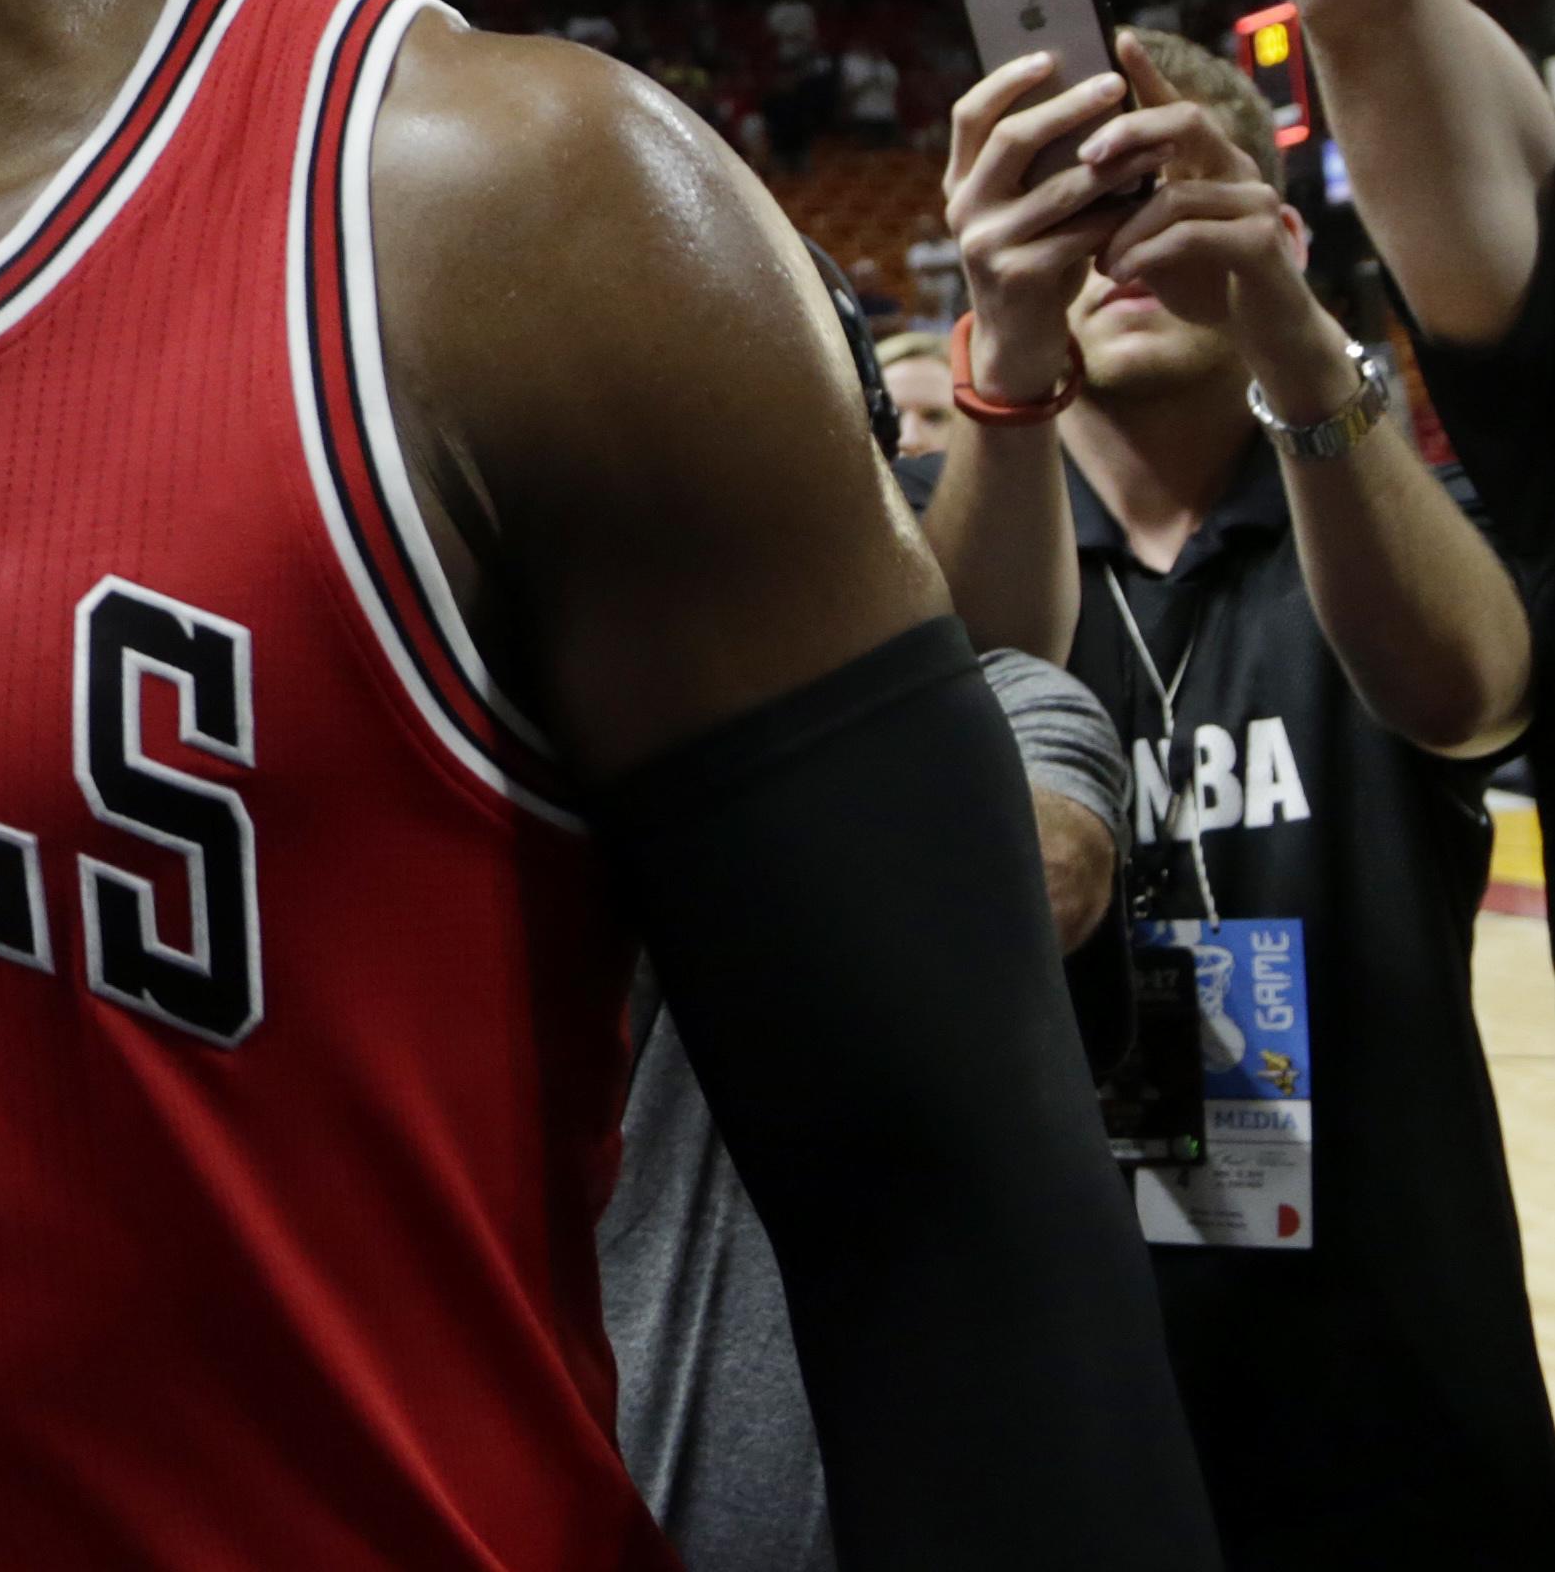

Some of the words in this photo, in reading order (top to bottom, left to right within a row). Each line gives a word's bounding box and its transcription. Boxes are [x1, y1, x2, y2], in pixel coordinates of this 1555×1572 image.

[1133, 715, 1311, 846] NBA
[1252, 929, 1294, 1032] GAME
[1213, 1109, 1298, 1133] MEDIA
